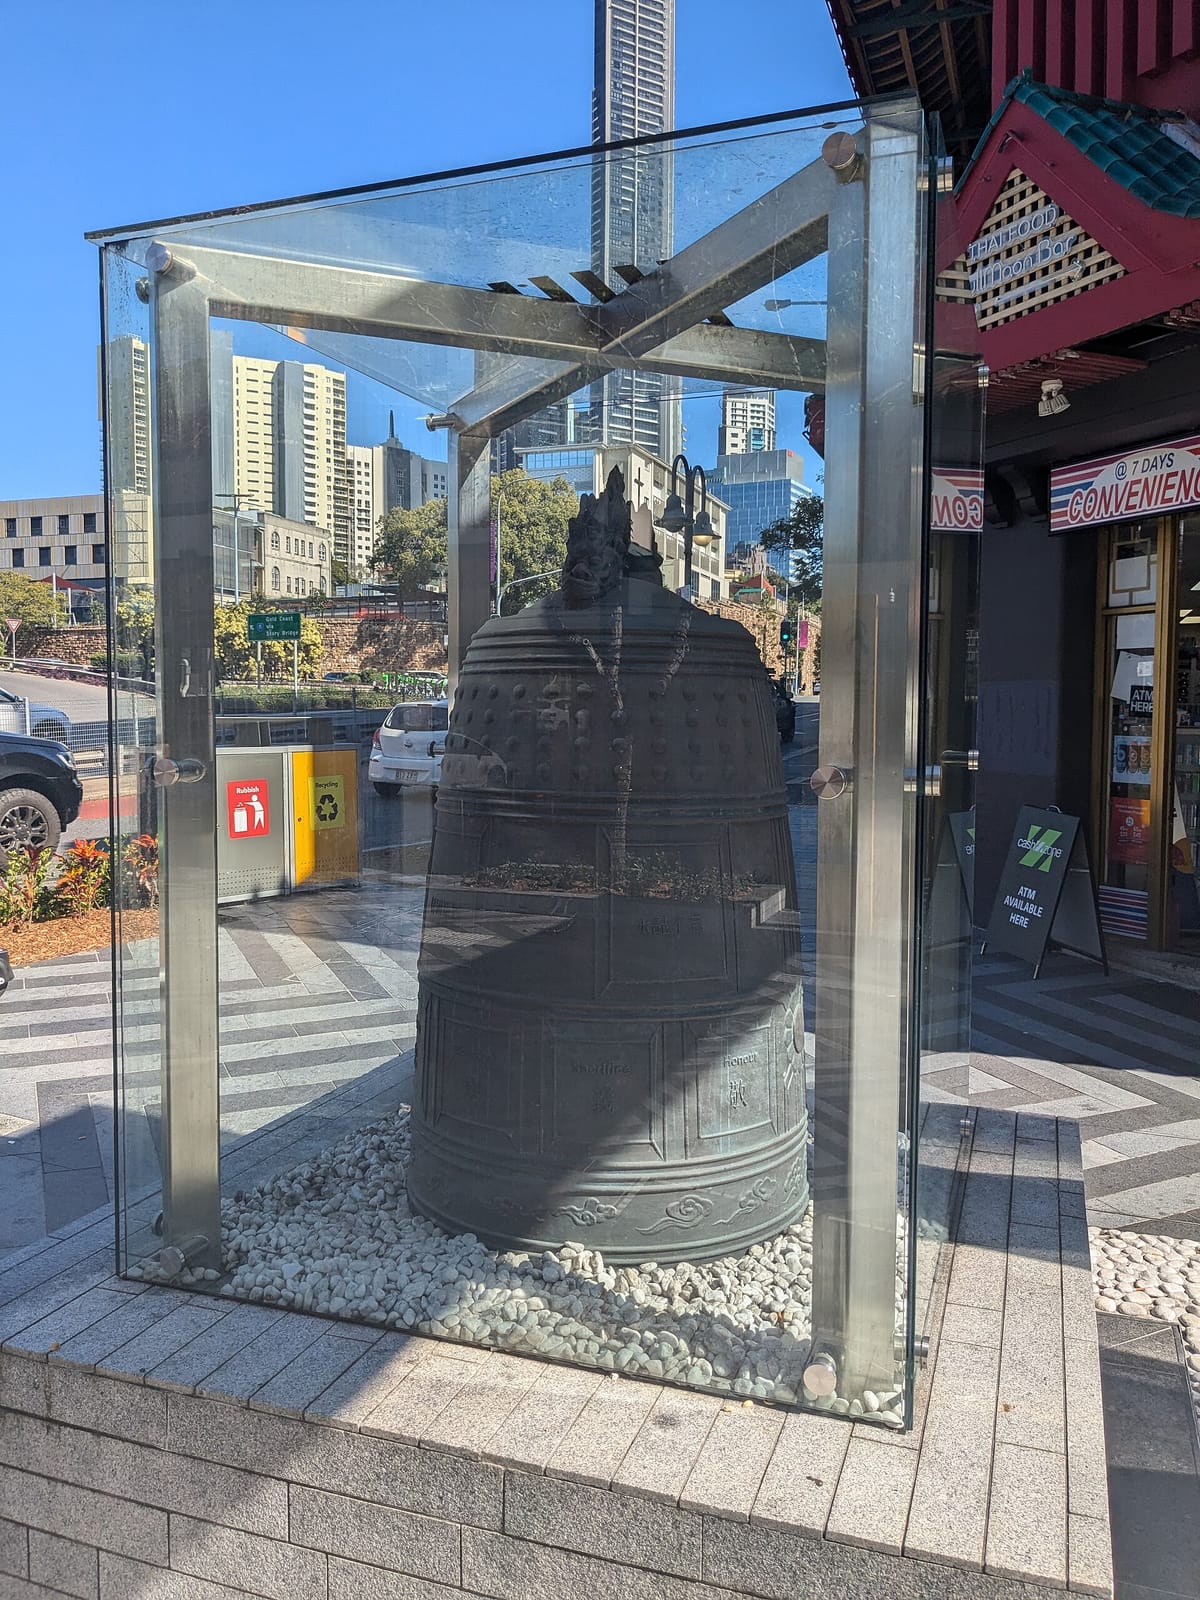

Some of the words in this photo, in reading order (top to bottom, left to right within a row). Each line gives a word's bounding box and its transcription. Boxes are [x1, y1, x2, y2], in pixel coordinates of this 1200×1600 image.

[968, 228, 1003, 260] THAI
[1008, 205, 1059, 243] FOOD
[1036, 235, 1077, 265] Bar
[1114, 461, 1128, 481] @
[1132, 460, 1141, 476] 7
[1141, 452, 1176, 474] DAYS
[1130, 701, 1153, 712] HERE
[236, 786, 260, 795] Rubbish
[315, 780, 339, 790] Recycling
[1018, 886, 1036, 900] ATM
[1003, 895, 1043, 917] AVAILABLE
[1009, 912, 1030, 928] HERE
[723, 1051, 758, 1068] Honour
